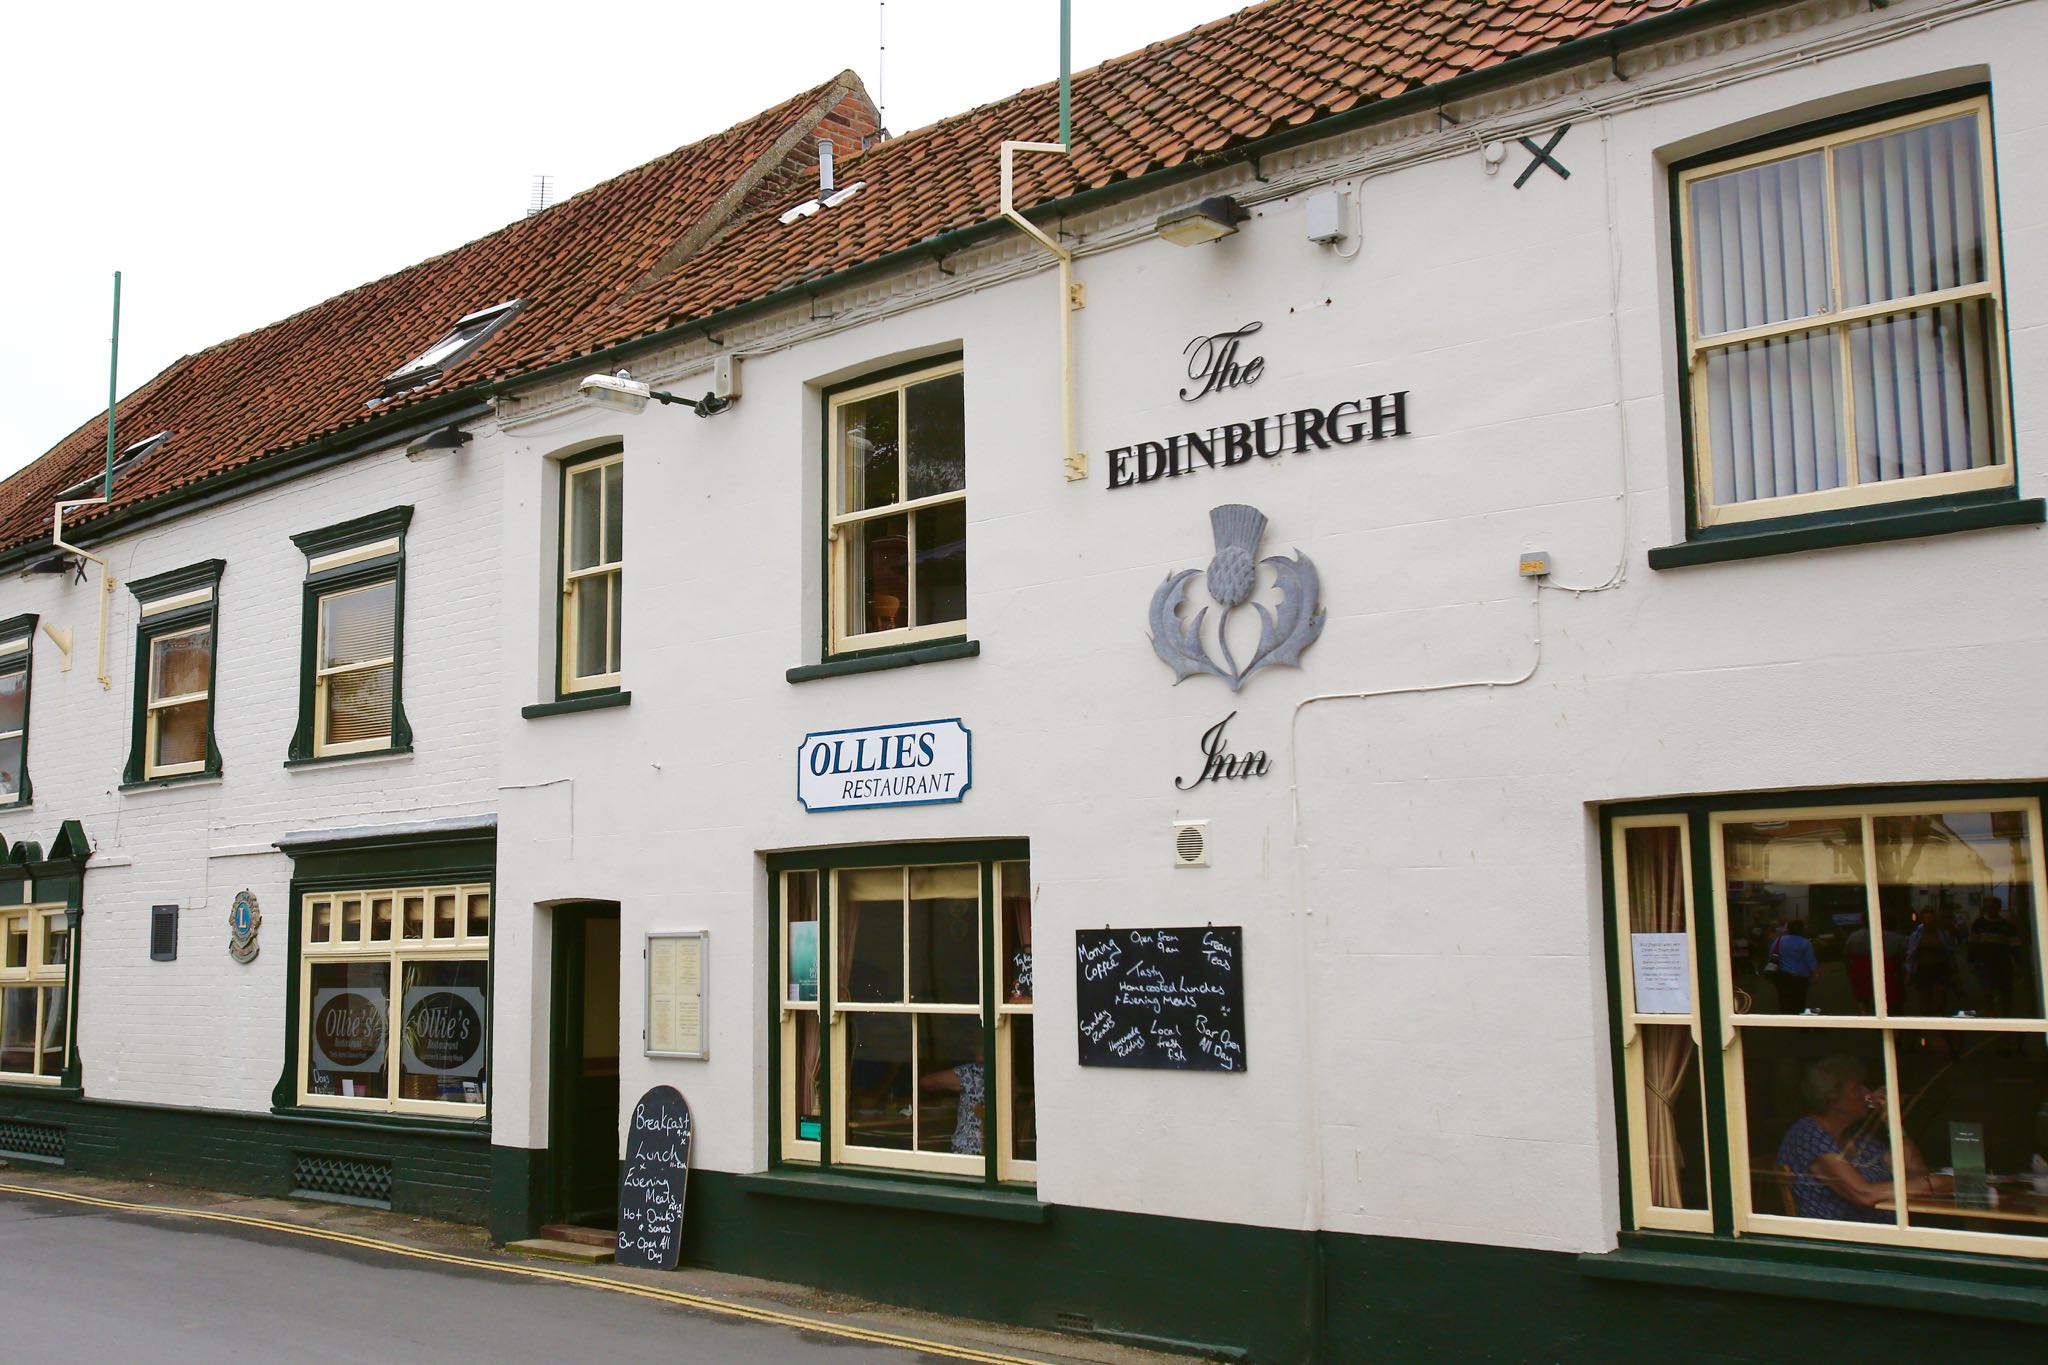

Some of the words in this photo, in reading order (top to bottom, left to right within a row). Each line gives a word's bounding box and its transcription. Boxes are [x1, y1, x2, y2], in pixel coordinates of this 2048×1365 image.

[1180, 321, 1265, 402] The
[1105, 390, 1412, 490] EDINBURGH
[810, 732, 936, 776] OLLIES
[1174, 710, 1273, 790] Inn
[842, 772, 955, 799] RESTAURANT
[1078, 938, 1122, 963] Morning
[1130, 930, 1153, 947] Open
[1157, 930, 1179, 942] from
[1202, 931, 1232, 957] Cream
[1084, 958, 1119, 981] Coffee
[1126, 960, 1165, 984] Tasty
[1202, 950, 1231, 971] Teas
[1179, 976, 1225, 996] Lunches
[1122, 993, 1161, 1014] Evening
[1162, 995, 1197, 1008] Meals
[325, 1008, 373, 1039] Ollie's
[417, 1008, 470, 1040] Ollie's
[1150, 1019, 1182, 1037] Local
[1195, 1014, 1219, 1038] Bar
[1220, 1029, 1241, 1053] Open
[1213, 1044, 1233, 1071] Day
[635, 1103, 690, 1137] Breakfast
[635, 1140, 681, 1163] Lunch
[624, 1166, 670, 1194] Evening
[623, 1207, 643, 1221] Hot
[646, 1207, 676, 1224] Drinks
[636, 1236, 657, 1253] Open
[647, 1248, 663, 1264] Day
